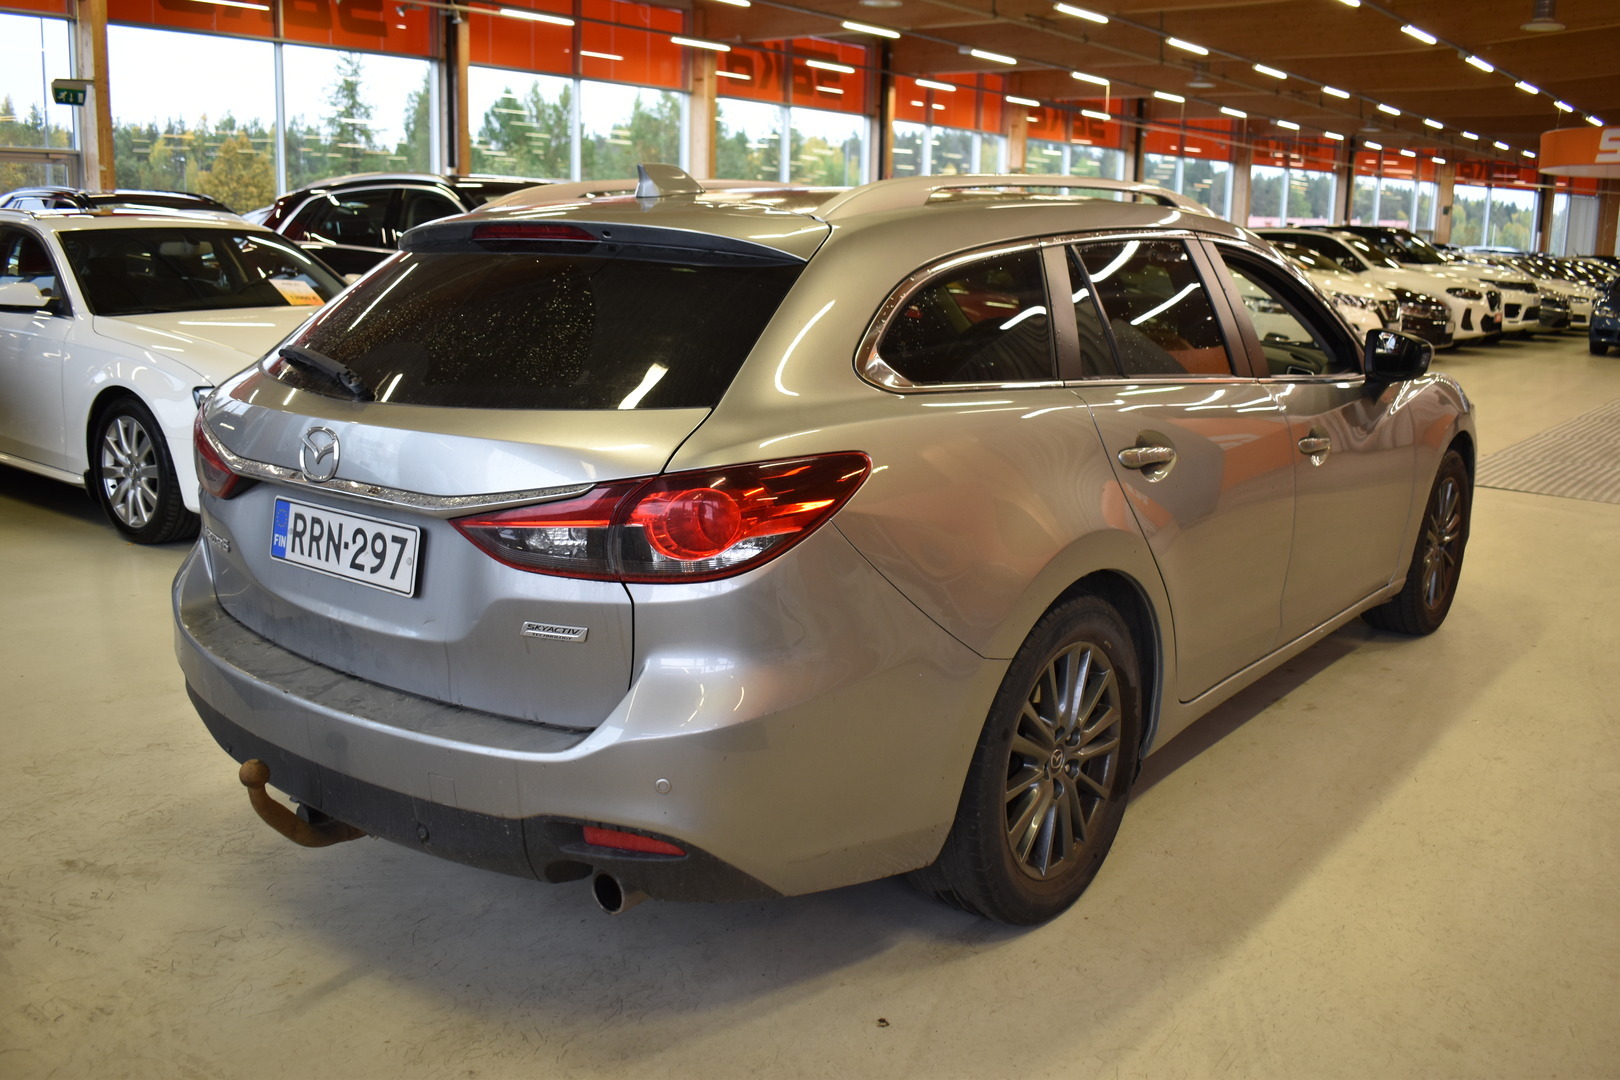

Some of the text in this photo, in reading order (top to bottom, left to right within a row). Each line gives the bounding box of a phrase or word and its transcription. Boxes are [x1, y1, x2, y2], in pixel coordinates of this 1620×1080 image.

[273, 534, 287, 548] FIN
[290, 512, 408, 580] RRN-297
[527, 623, 580, 635] SKYACTIV
